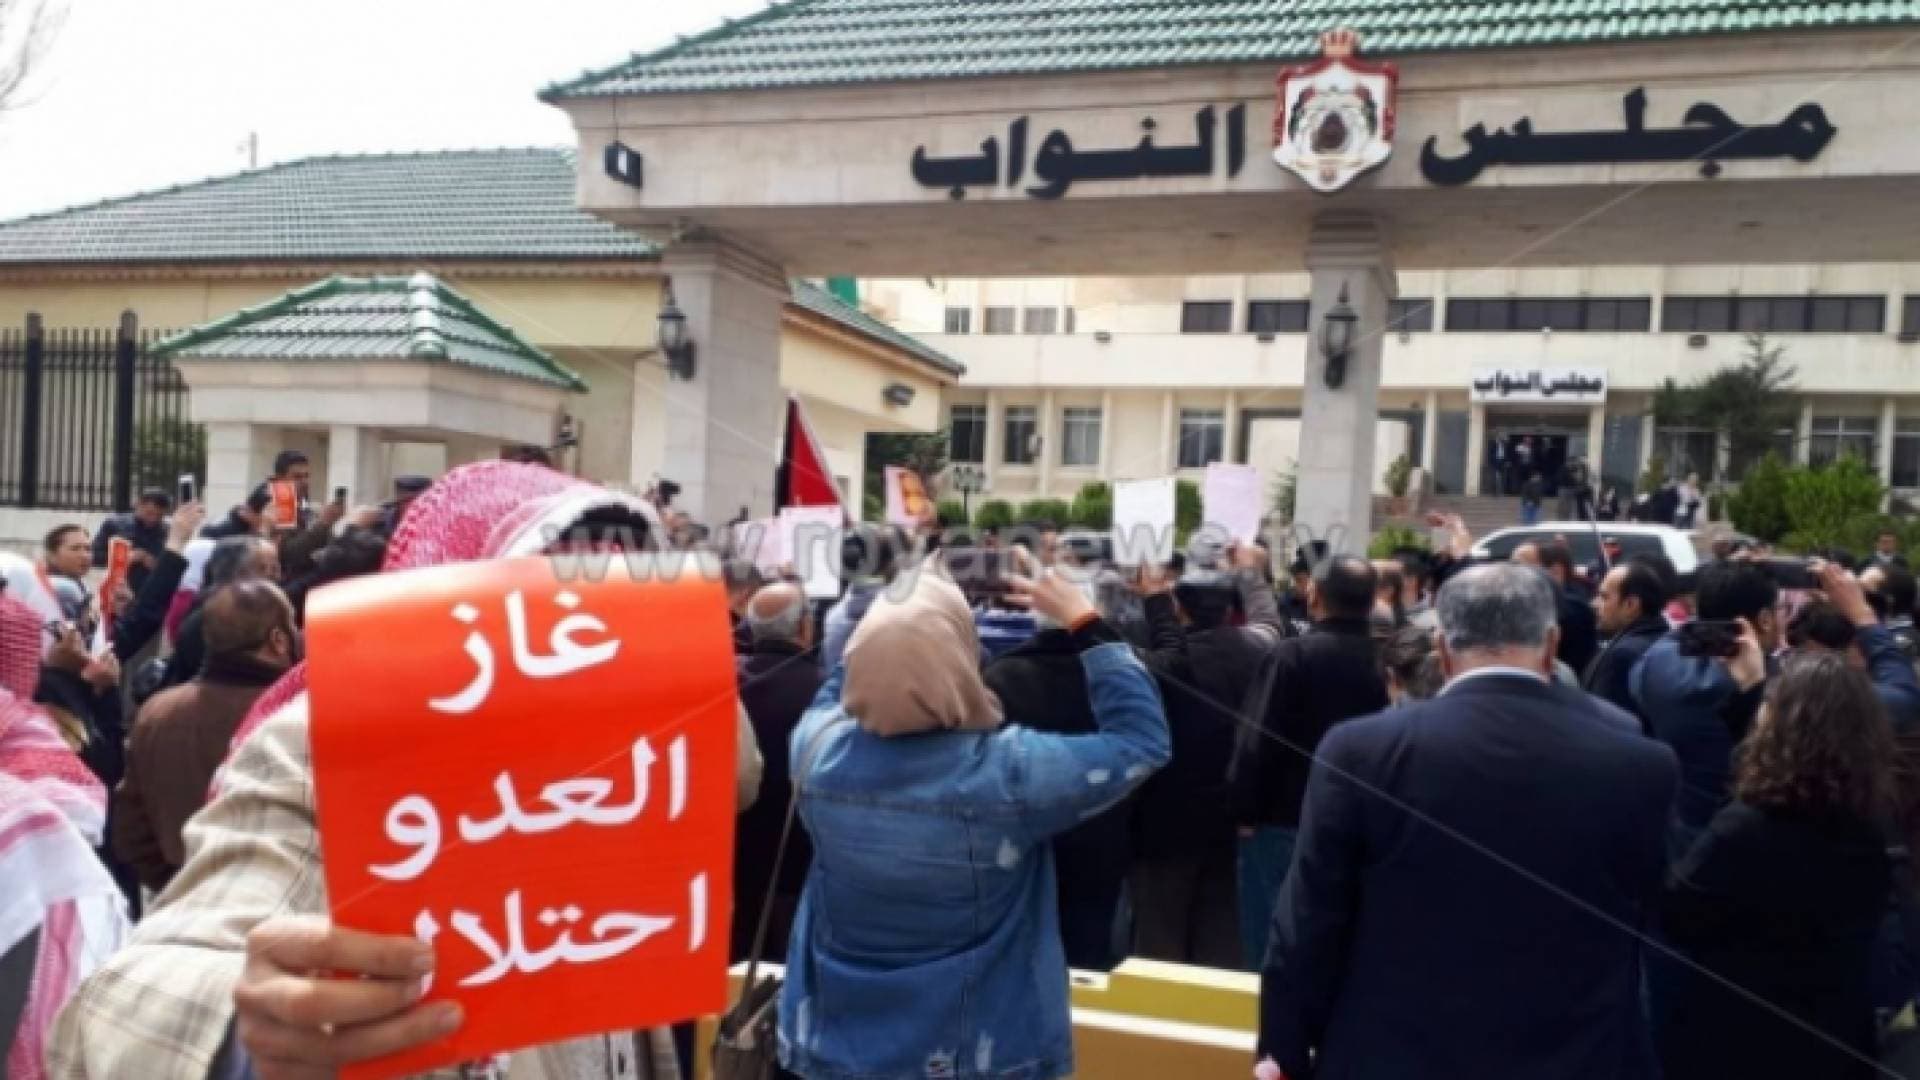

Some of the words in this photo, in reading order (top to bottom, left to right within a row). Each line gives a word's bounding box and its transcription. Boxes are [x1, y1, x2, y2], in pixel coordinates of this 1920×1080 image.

[911, 101, 1246, 200] النواب
[1419, 86, 1836, 184] مجلس
[1474, 370, 1540, 400] النواب
[1541, 371, 1603, 400] مجلس
[428, 590, 621, 713] غاز
[367, 734, 688, 880] العدو
